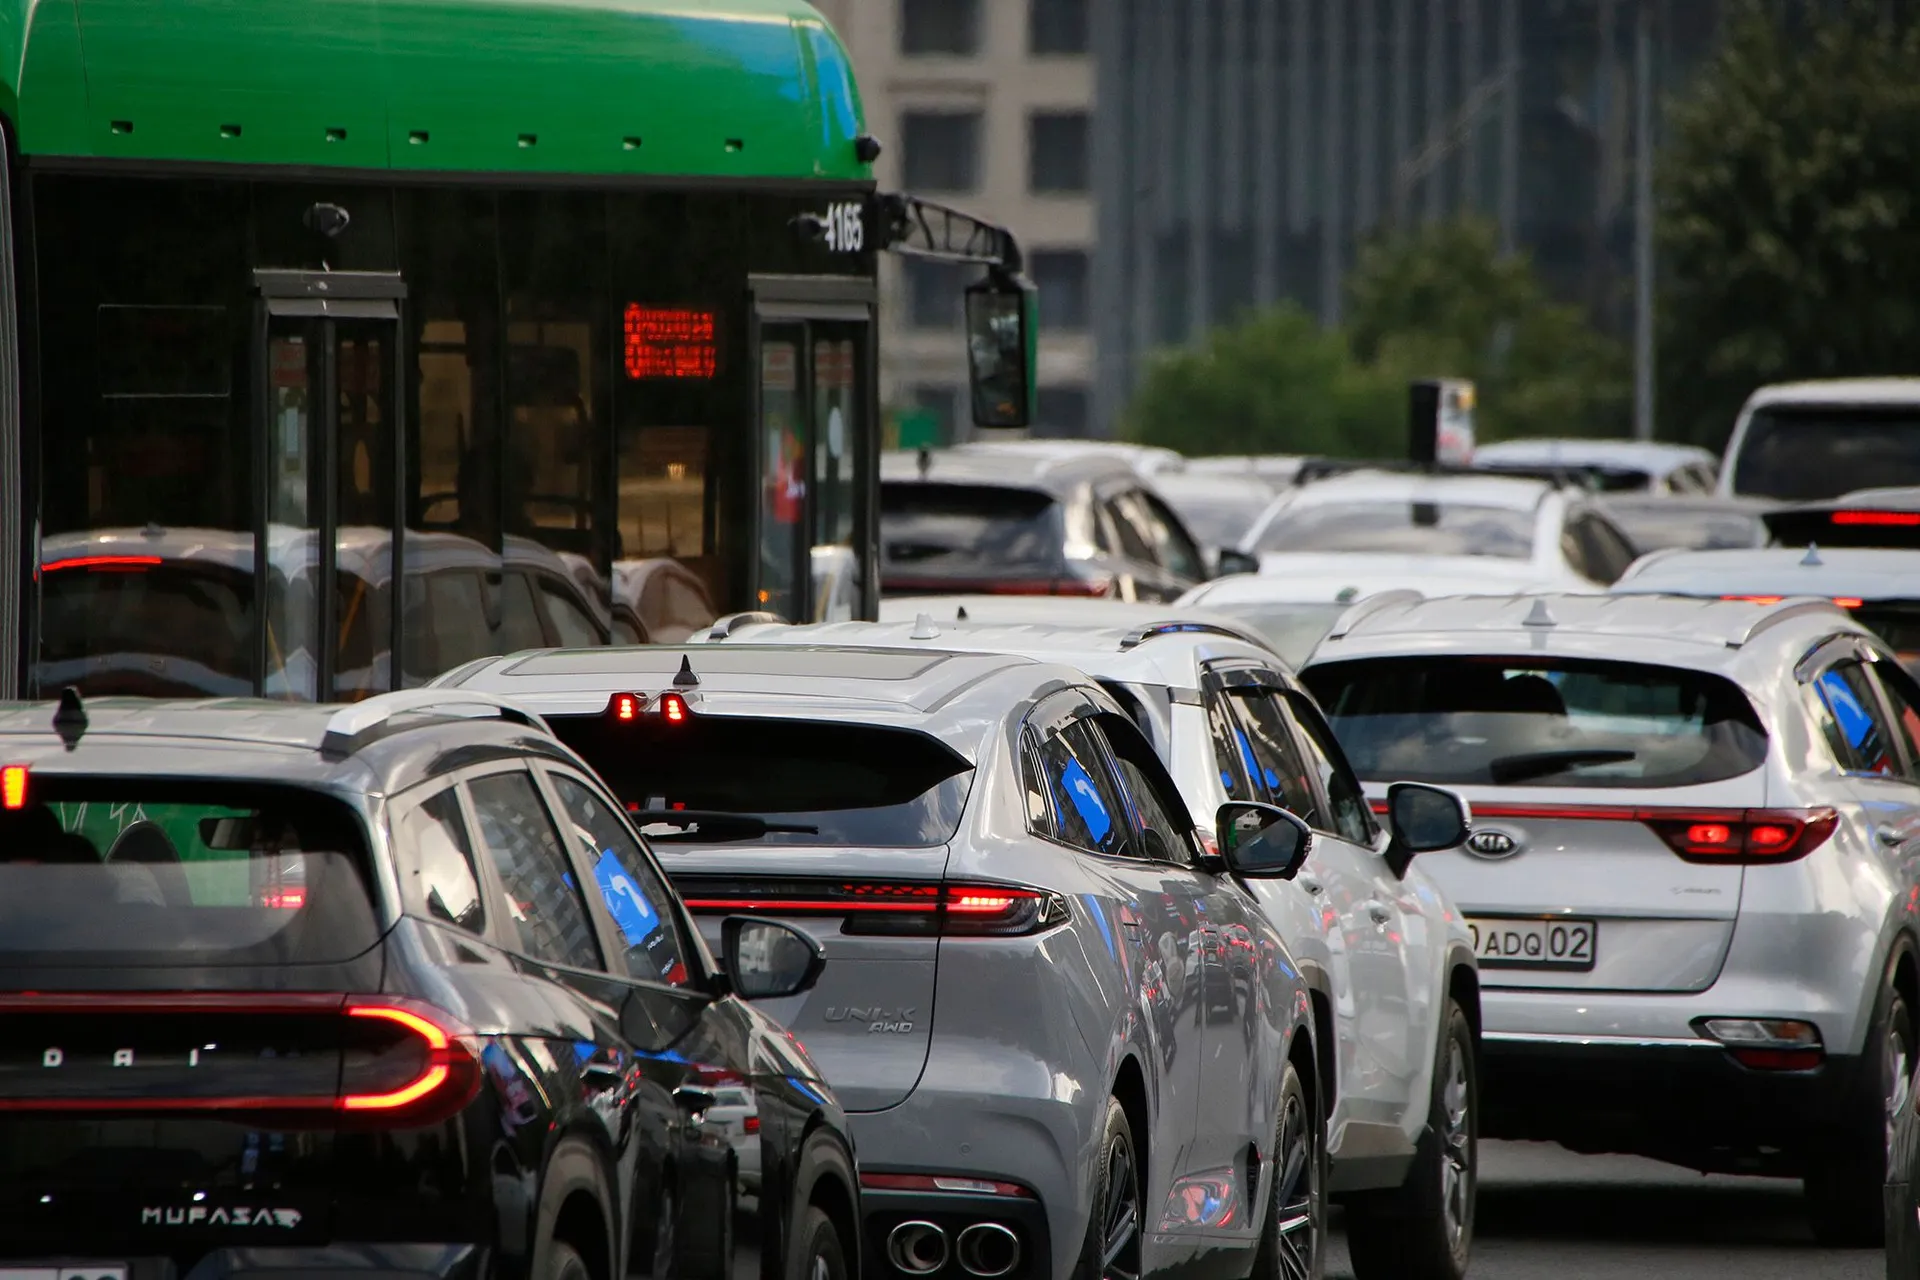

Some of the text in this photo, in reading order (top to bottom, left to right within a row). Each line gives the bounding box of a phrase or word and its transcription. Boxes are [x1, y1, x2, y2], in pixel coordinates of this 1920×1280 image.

[824, 203, 863, 251] 4165
[1474, 835, 1510, 850] KIA
[1485, 931, 1543, 956] ADQ
[1549, 926, 1589, 958] 02
[868, 1022, 913, 1033] AWD
[142, 1207, 274, 1225] MUFASA
